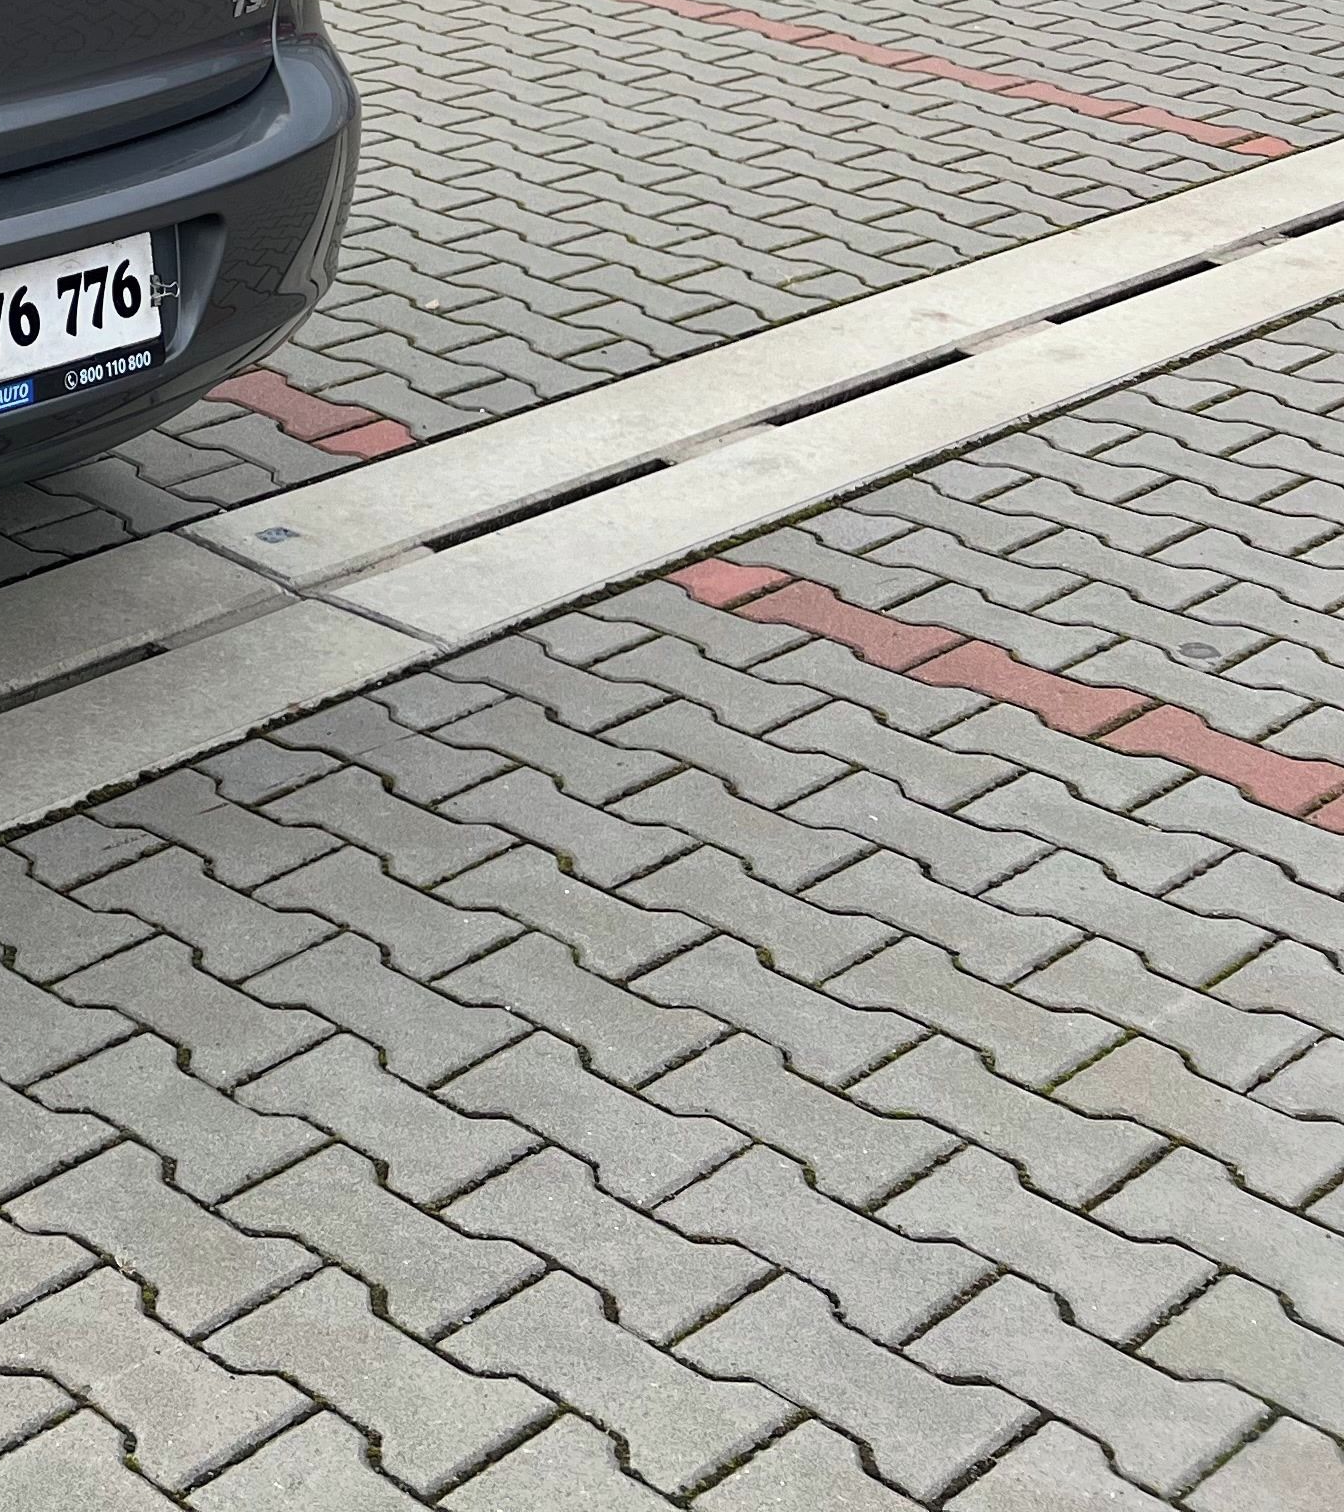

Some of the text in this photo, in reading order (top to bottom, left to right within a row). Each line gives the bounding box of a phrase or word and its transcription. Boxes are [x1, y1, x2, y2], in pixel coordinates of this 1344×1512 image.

[57, 259, 142, 337] 776
[79, 350, 152, 385] 800 110 800
